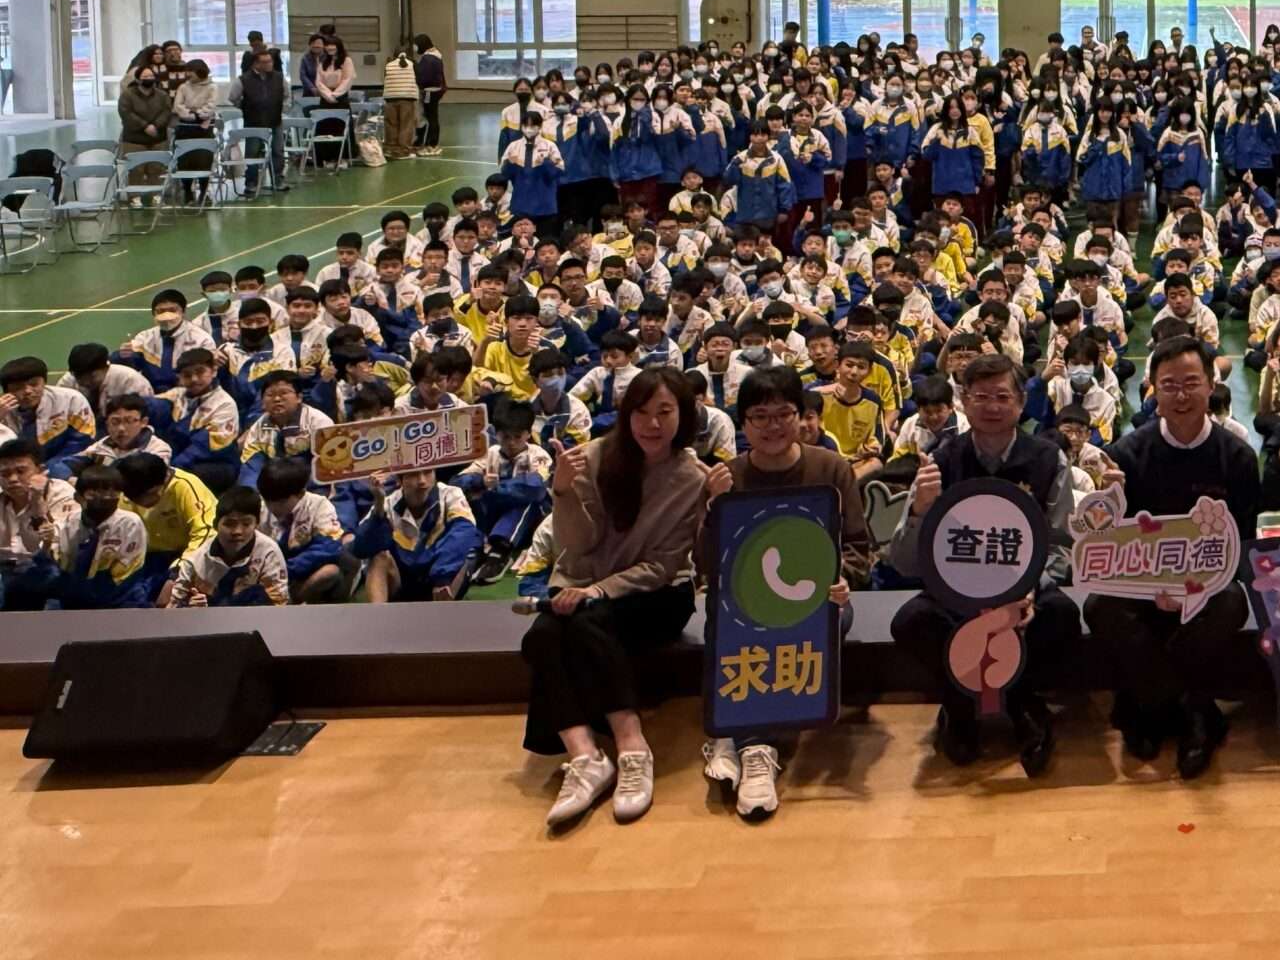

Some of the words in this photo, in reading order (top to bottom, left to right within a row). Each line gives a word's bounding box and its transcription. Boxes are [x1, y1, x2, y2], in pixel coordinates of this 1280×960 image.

[945, 524, 1023, 567] 查證
[1081, 537, 1226, 580] 同心同德
[718, 640, 823, 702] 求助
